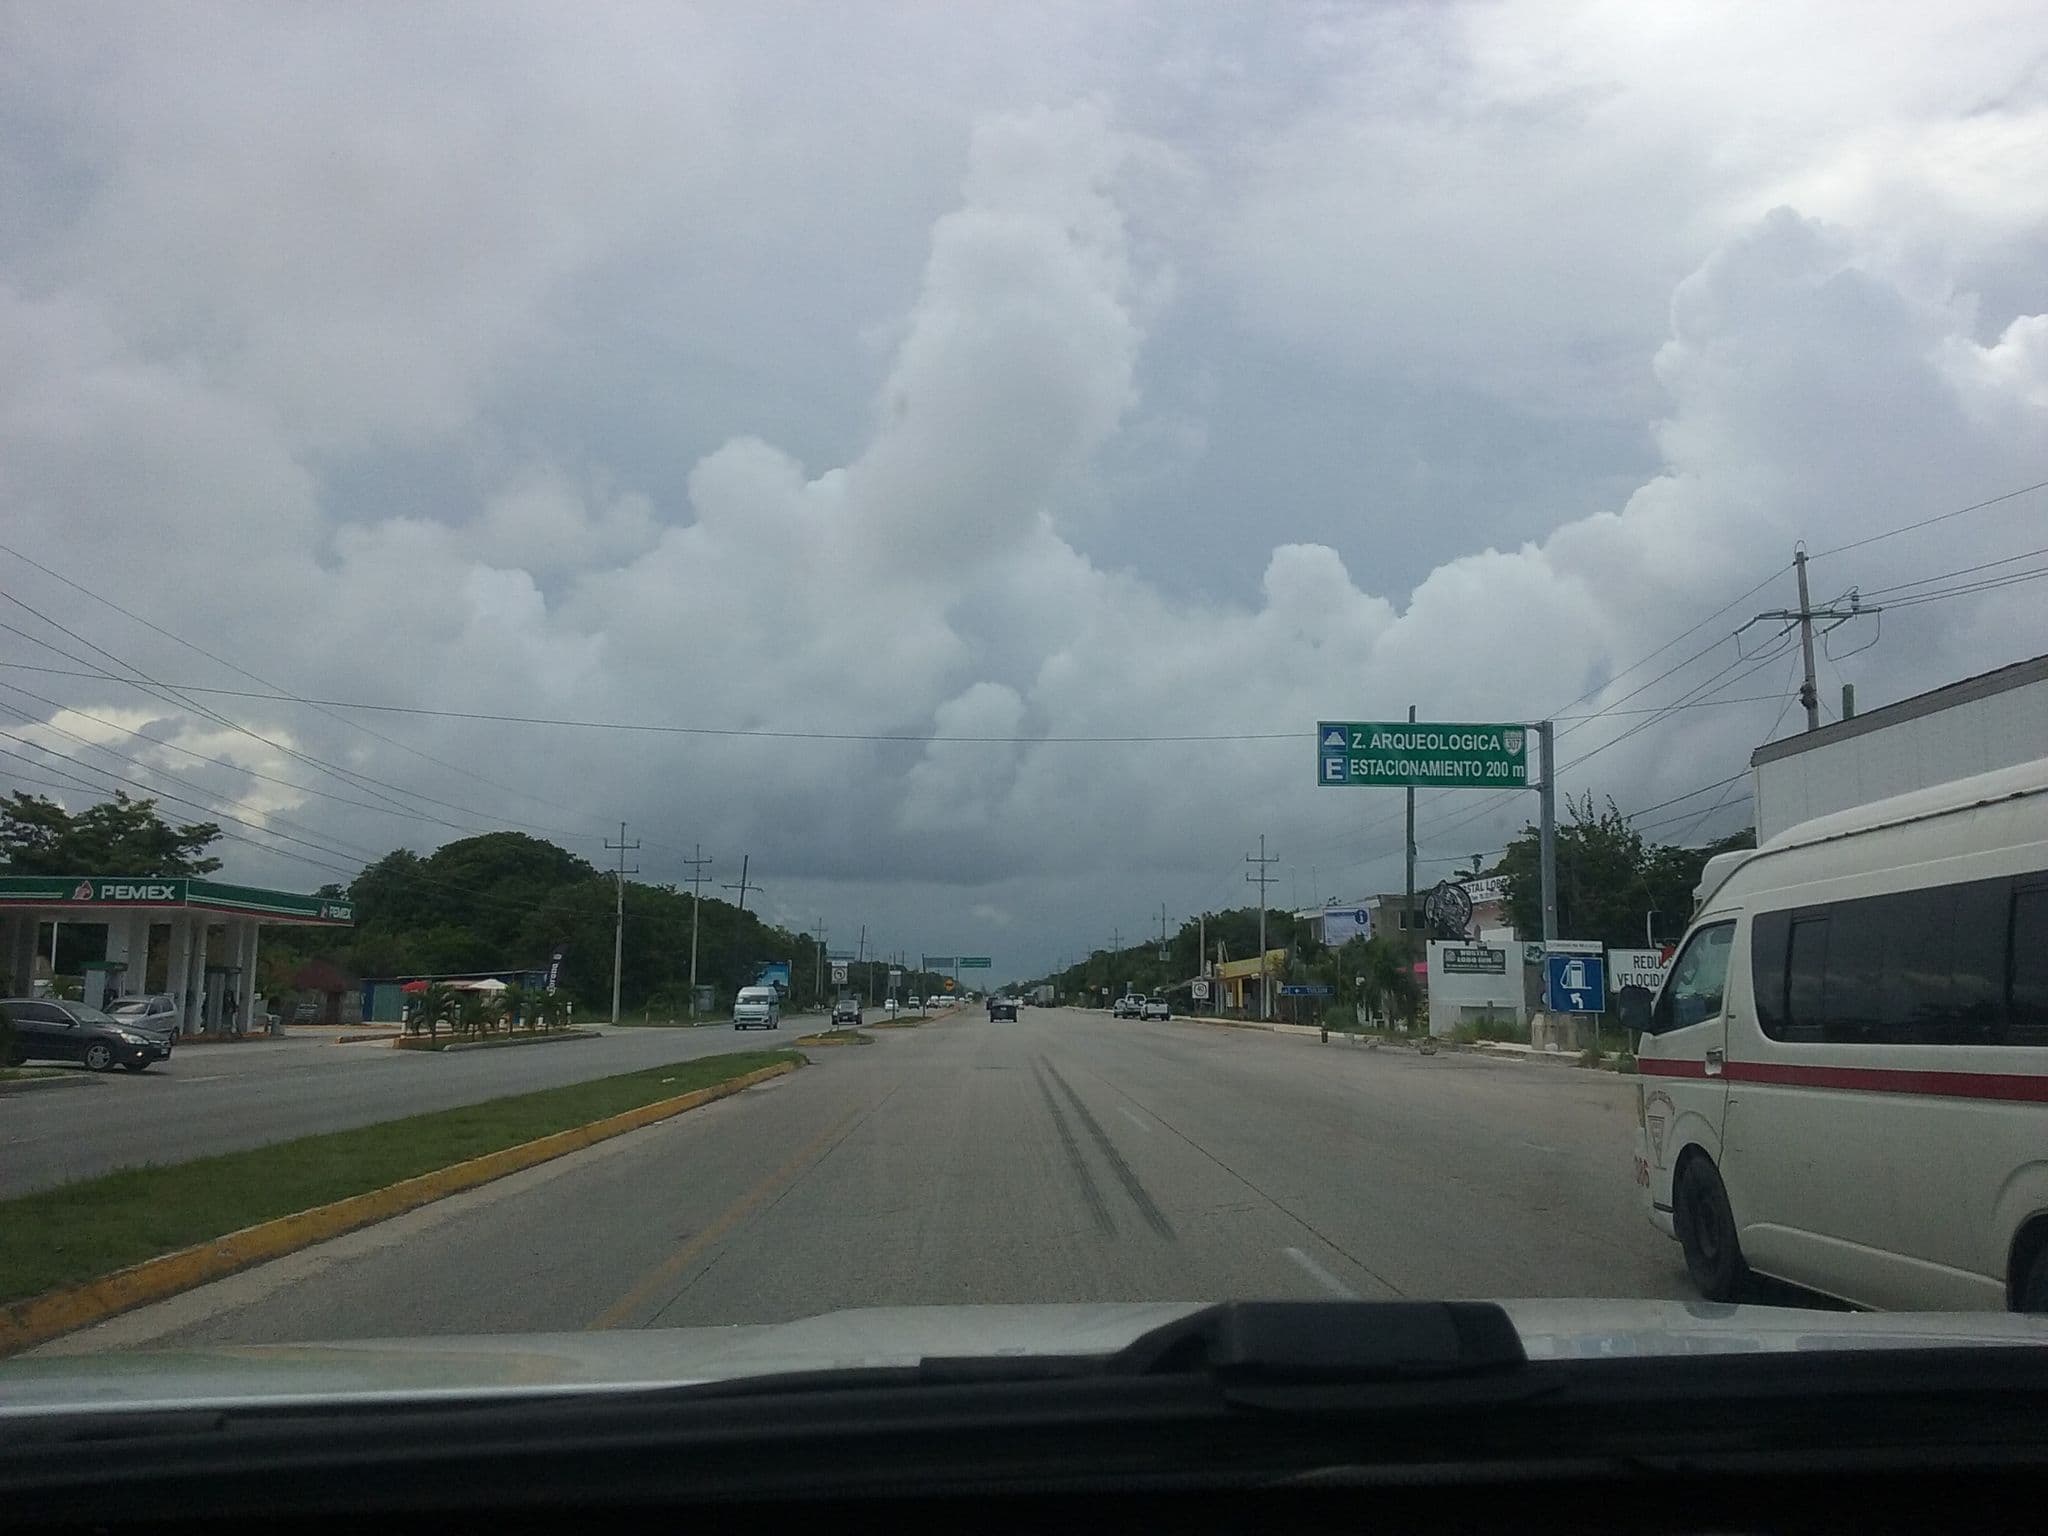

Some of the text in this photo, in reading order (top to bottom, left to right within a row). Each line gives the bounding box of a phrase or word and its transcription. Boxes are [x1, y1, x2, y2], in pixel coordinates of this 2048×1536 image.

[1351, 733, 1501, 751] Z. ARQUEOLOGICA
[1507, 739, 1520, 749] 307
[1326, 758, 1344, 780] E
[1350, 759, 1525, 777] ESTACIONAMIENTO 200 m
[101, 884, 175, 900] PEMEX
[329, 905, 352, 920] PEMEX
